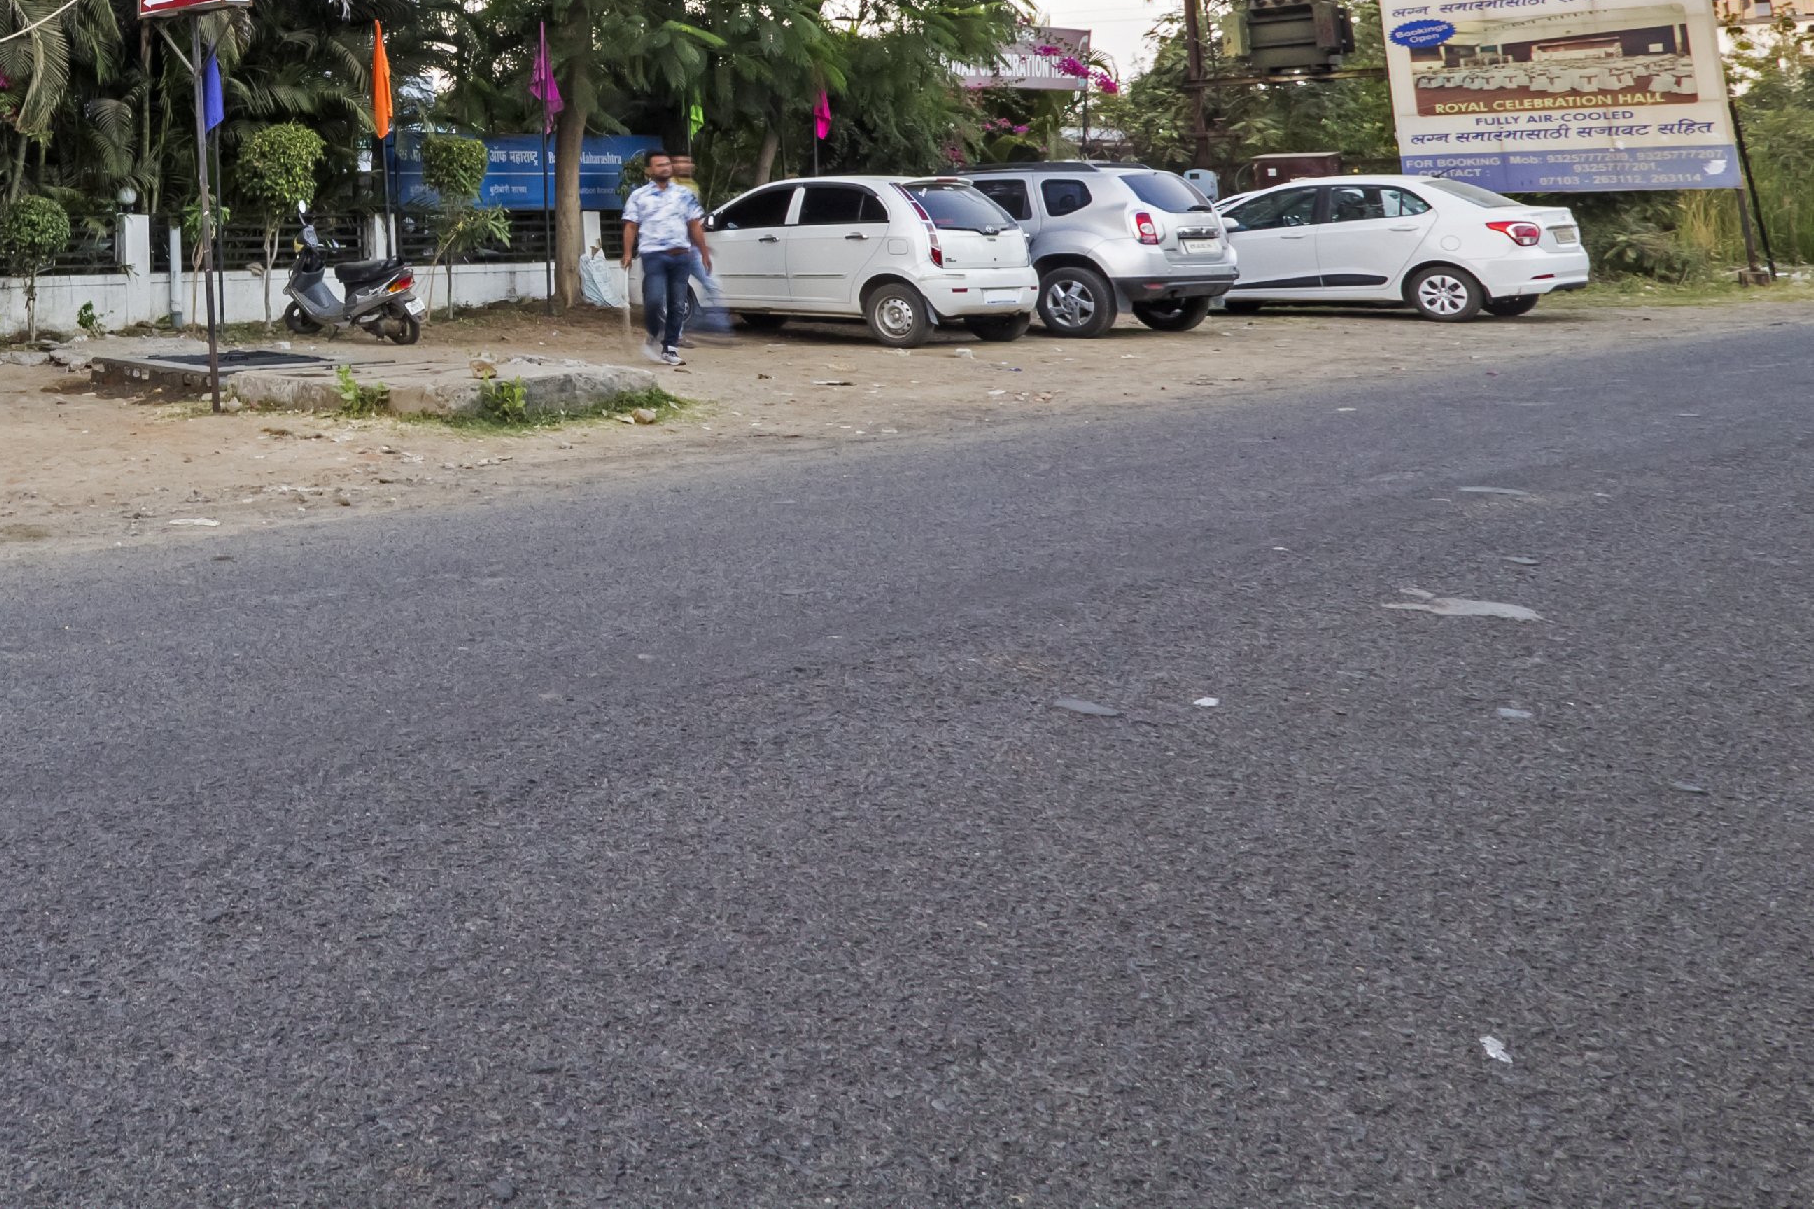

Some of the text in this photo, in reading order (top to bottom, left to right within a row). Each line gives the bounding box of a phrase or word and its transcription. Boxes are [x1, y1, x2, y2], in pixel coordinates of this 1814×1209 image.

[1394, 23, 1449, 39] Bookings
[1409, 33, 1440, 44] Open
[1436, 92, 1666, 114] ROYAL CELEBRATION HALL
[1475, 110, 1634, 126] FULLY AIR-COOLED
[1576, 124, 1652, 138] सजावट
[1657, 118, 1715, 136] सहित
[1405, 156, 1500, 168] FOR BOOKING
